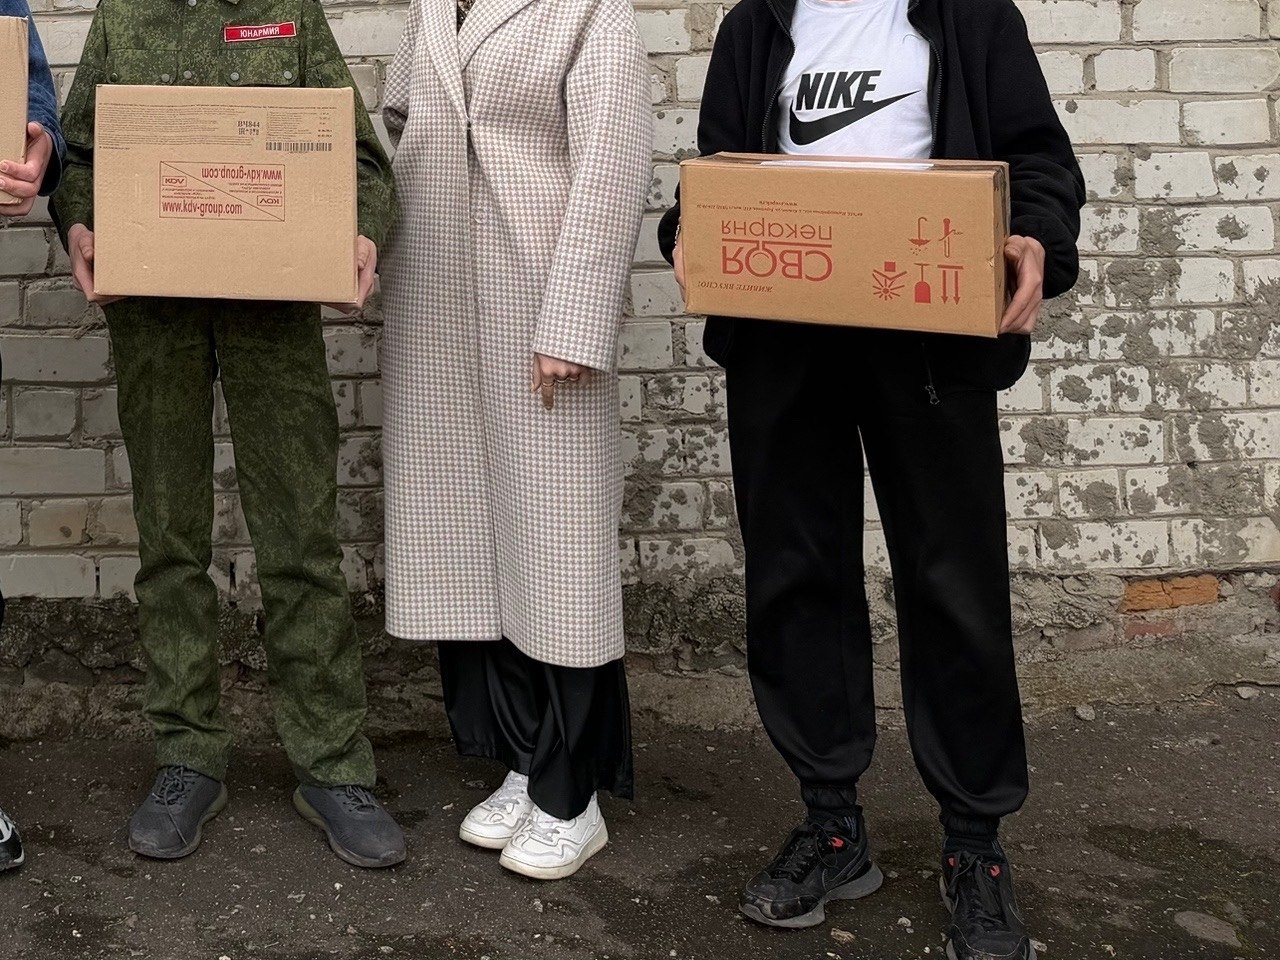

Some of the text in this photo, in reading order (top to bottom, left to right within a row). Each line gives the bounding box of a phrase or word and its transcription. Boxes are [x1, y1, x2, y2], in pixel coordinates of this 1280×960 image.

[240, 27, 280, 38] ЮНАРМИЯ
[796, 70, 882, 111] NIKE
[201, 165, 282, 183] www.kdv-group.com
[162, 199, 242, 217] www.kdv-group.com
[721, 217, 832, 241] пекарня
[721, 243, 833, 282] СВОЯ
[736, 283, 773, 293] ЖИВИТЕ
